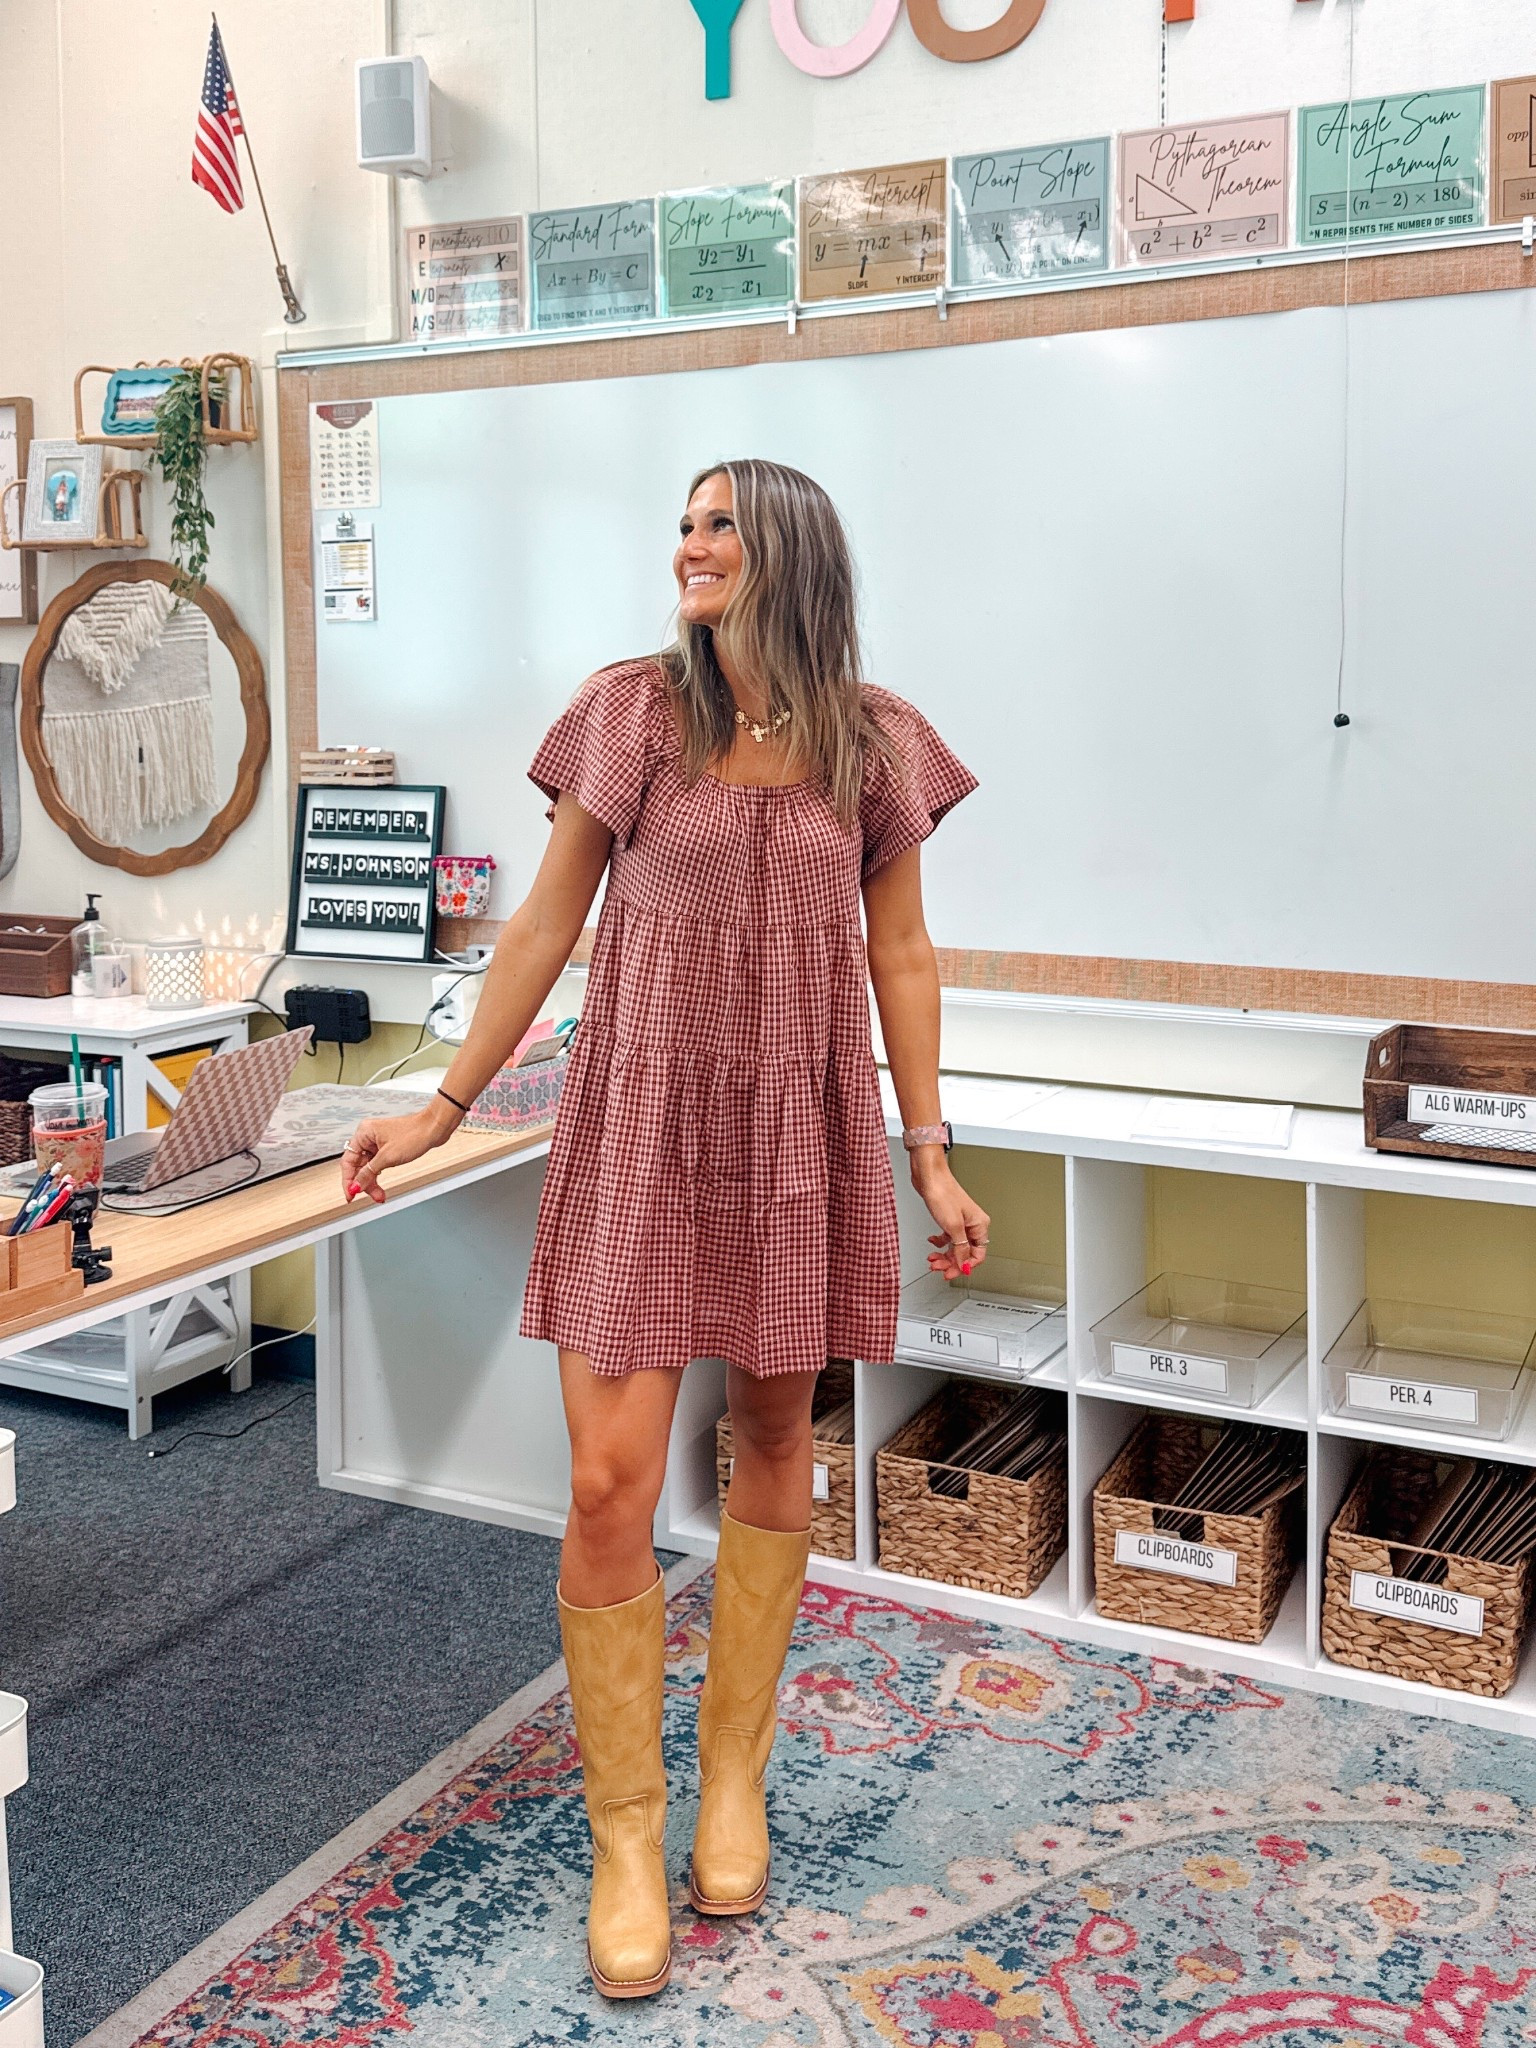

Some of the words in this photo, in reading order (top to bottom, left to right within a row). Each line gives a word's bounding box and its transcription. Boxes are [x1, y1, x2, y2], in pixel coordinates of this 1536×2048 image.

[1317, 99, 1391, 159] Angle
[1400, 93, 1460, 146] Sum
[1506, 130, 1529, 142] opp
[1149, 131, 1272, 187] Pythagorean
[1363, 135, 1459, 194] Formula
[969, 157, 1041, 206] Point
[1039, 148, 1096, 198] Slope
[1203, 158, 1281, 213] Theorem
[863, 169, 945, 222] Intercept
[1316, 200, 1328, 216] S
[1434, 186, 1461, 203] 180
[667, 200, 714, 245] Slope
[1379, 222, 1394, 233] THE
[1397, 218, 1432, 231] NUMBER
[1434, 217, 1446, 227] OF
[1448, 214, 1473, 226] SIDES
[418, 234, 426, 250] P
[531, 214, 603, 260] Standard
[857, 233, 891, 252] mx
[419, 261, 426, 277] E
[626, 263, 638, 280] C
[1062, 258, 1072, 266] ON
[847, 279, 869, 290] SLOPE
[902, 272, 939, 284] INTERCEPT
[412, 315, 435, 332] A/S
[314, 810, 425, 830] REMEMBER,
[306, 855, 338, 871] MS.
[343, 857, 430, 875] JOHNSON
[310, 900, 367, 917] LOVES
[373, 903, 419, 920] YOU!
[1425, 1093, 1450, 1112] ALG
[1454, 1096, 1526, 1119] WARM-UPS
[929, 1327, 954, 1347] PER.
[957, 1332, 962, 1348] 1
[1150, 1354, 1177, 1374] PER.
[1179, 1359, 1188, 1376] 3
[1390, 1384, 1419, 1404] PER.
[1422, 1389, 1433, 1406] 4
[1137, 1538, 1214, 1570] CLIPBOARDS
[1375, 1581, 1458, 1617] CLIPBOARDS
